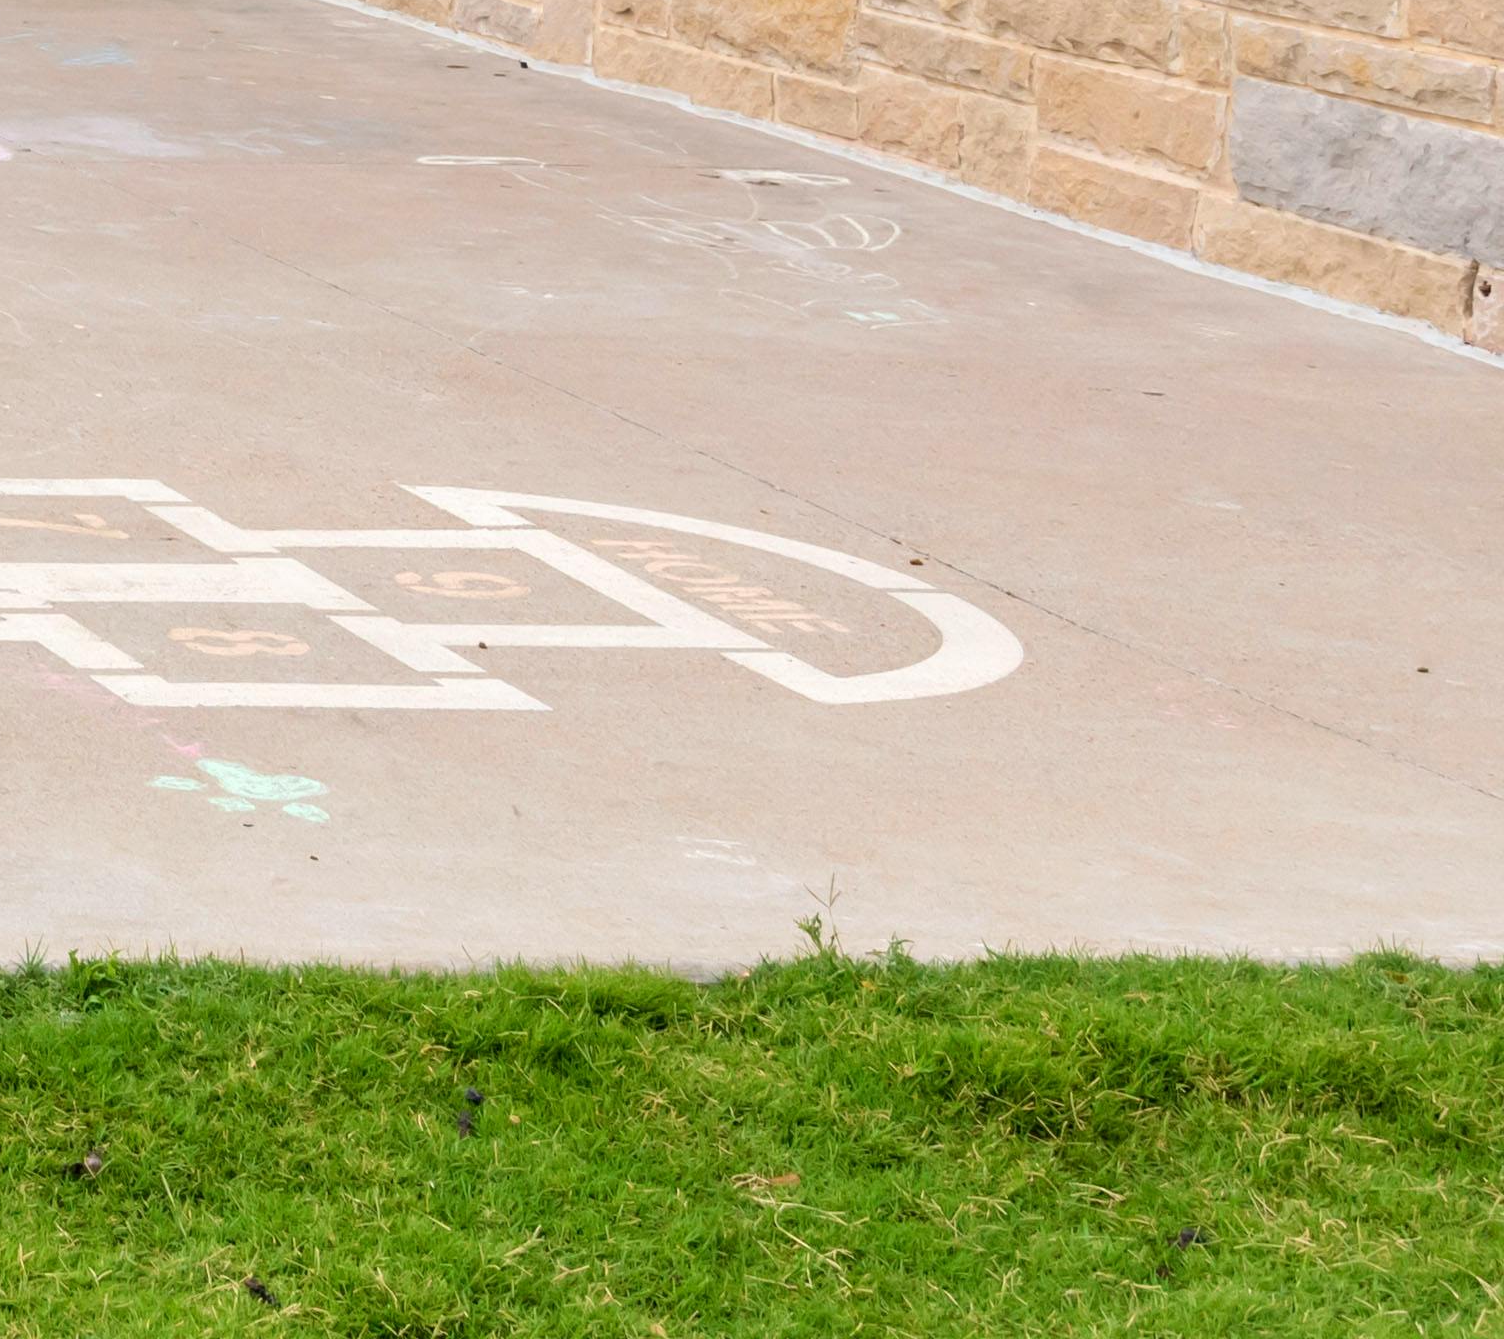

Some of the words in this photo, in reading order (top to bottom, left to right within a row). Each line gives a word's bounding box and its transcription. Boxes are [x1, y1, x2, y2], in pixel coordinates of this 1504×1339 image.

[394, 570, 532, 599] 9
[590, 538, 852, 635] HOME
[166, 627, 311, 656] 8
